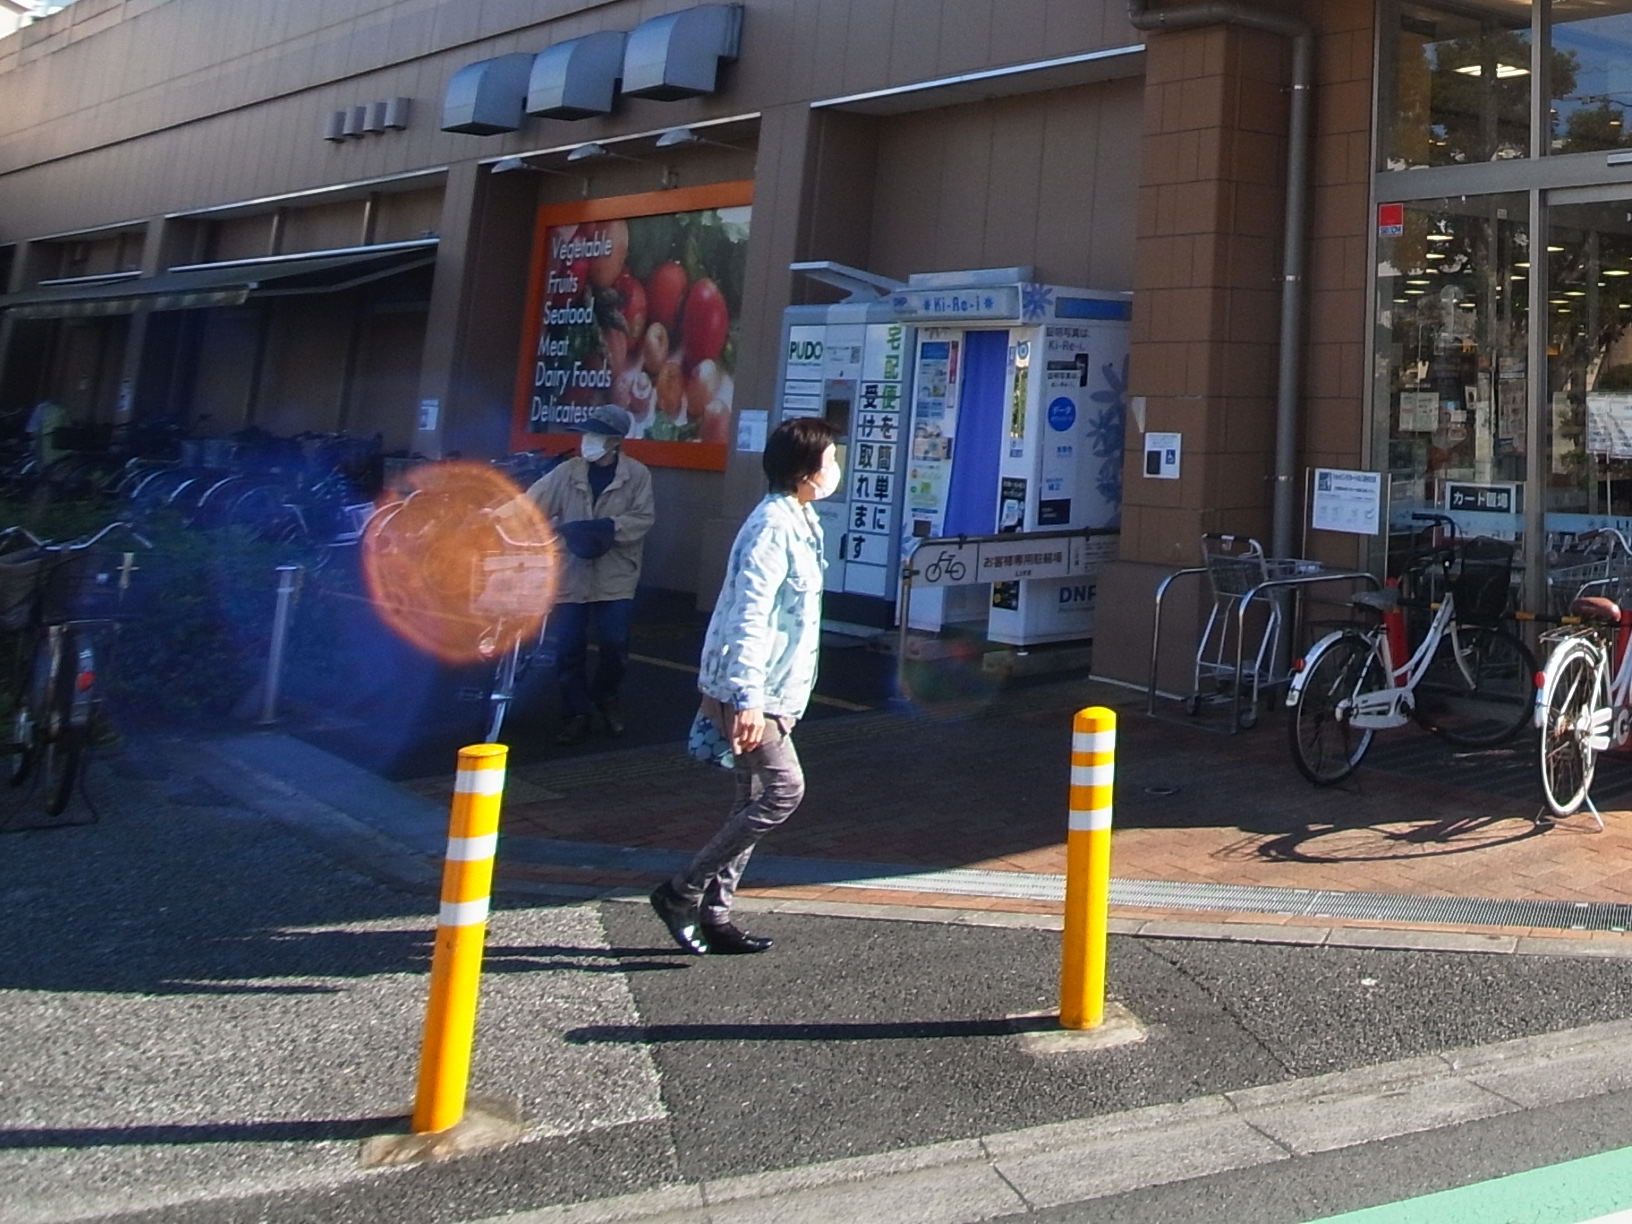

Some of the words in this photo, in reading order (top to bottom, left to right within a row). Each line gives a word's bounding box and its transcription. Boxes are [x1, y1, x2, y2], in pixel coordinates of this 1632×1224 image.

[552, 230, 613, 266] Vegetable
[547, 270, 578, 294] Fruits
[543, 296, 595, 325] Seafood
[538, 335, 570, 356] Meat
[788, 341, 824, 360] PUDO
[535, 362, 571, 395] Dairy
[572, 359, 611, 388] Foods
[873, 326, 902, 531] 宅配便を簡単に
[852, 384, 879, 559] 受け取れます
